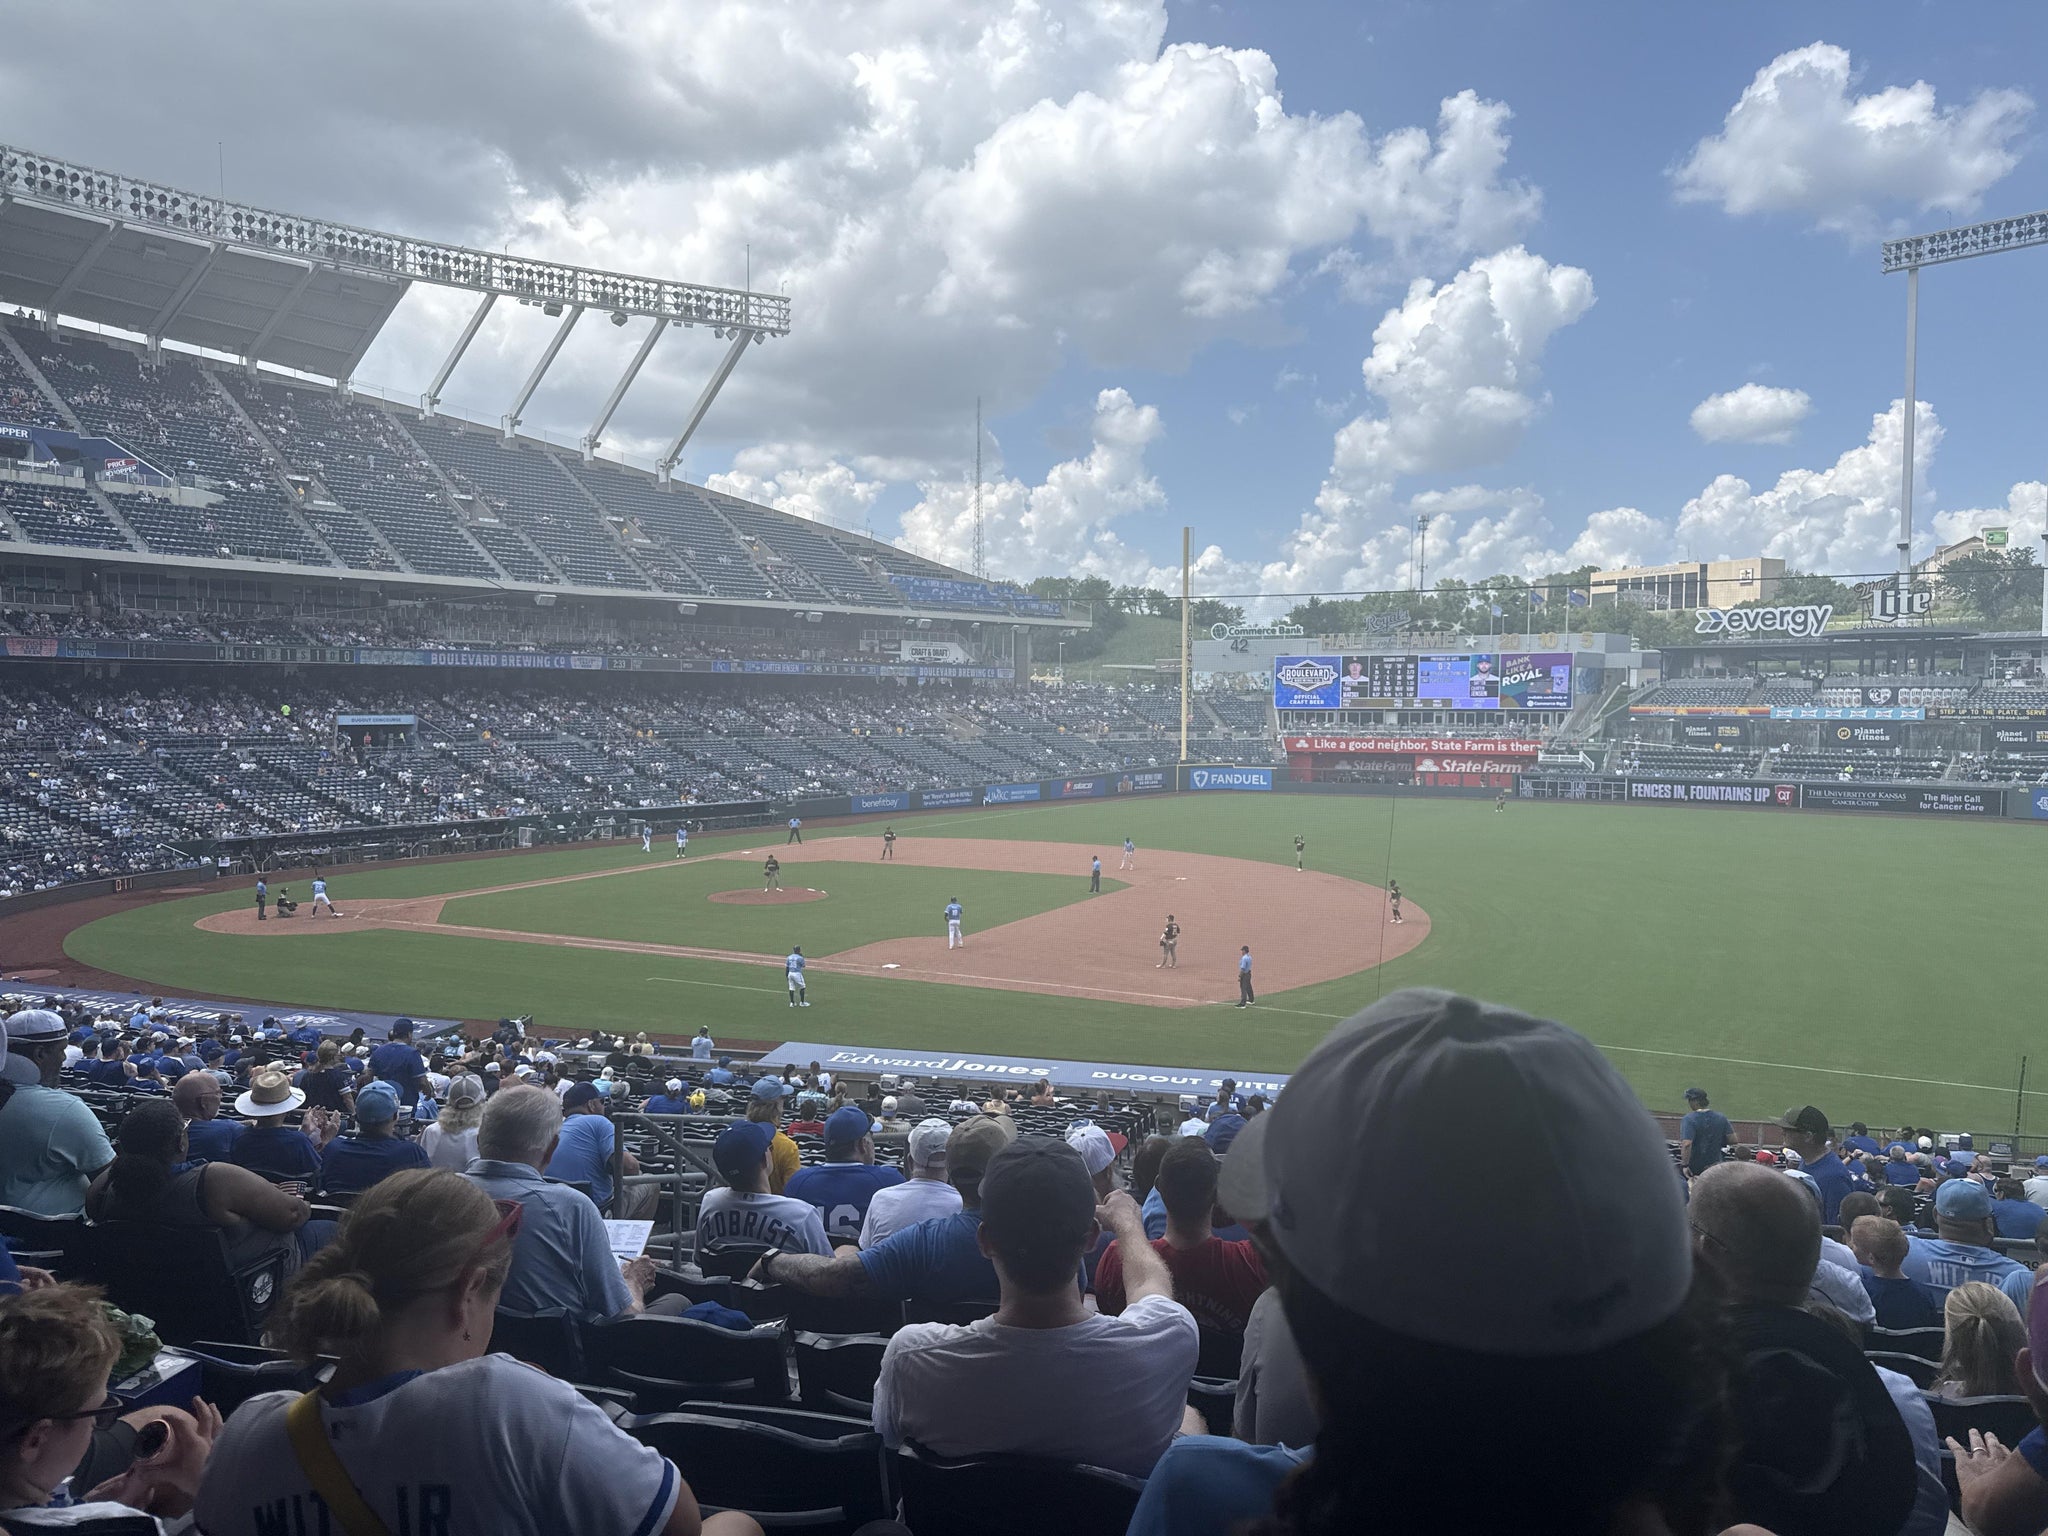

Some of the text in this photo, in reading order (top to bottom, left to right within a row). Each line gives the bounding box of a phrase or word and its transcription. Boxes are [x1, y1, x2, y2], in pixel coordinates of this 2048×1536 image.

[107, 460, 126, 469] PRICE
[1854, 580, 1894, 600] Miller
[1869, 589, 1932, 622] Lite
[1365, 608, 1411, 633] Royals
[1726, 606, 1831, 635] evergy
[1228, 625, 1303, 636] Commerce Bank
[1230, 639, 1248, 653] 42
[1321, 633, 1374, 649] HALL
[1397, 631, 1457, 649] FAME
[1501, 633, 1520, 649] 20
[1539, 632, 1557, 648] 10
[1581, 632, 1594, 648] 5
[911, 647, 927, 656] CRAFT
[932, 648, 948, 657] DRAFT
[431, 653, 498, 667] BOULEVARD
[501, 654, 551, 668] BREWING
[1505, 655, 1531, 668] BANK
[762, 663, 781, 672] CARTER
[782, 664, 800, 673] JENSEN
[919, 667, 957, 677] BOULEVARD
[958, 668, 986, 678] BREWING
[1285, 668, 1330, 681] BOULEVARD
[1505, 664, 1526, 675] LIKE
[1502, 668, 1543, 687] ROYAL
[1854, 727, 1884, 736] planet
[1858, 733, 1890, 741] fitness
[1996, 730, 2022, 738] planet
[1314, 740, 1337, 749] Like
[1349, 740, 1374, 751] good
[1377, 740, 1428, 752] neighbor,
[1431, 741, 1462, 751] State
[1465, 741, 1494, 751] Farm
[1498, 741, 1507, 751] is
[1352, 760, 1412, 771] State Farm
[1441, 759, 1522, 773] State Farm
[1210, 774, 1268, 785] FANDUEL
[1631, 783, 1770, 802] FENCES IN, FOUNTAINS UP
[1777, 790, 1791, 801] QT
[1807, 789, 1822, 797] THE
[1823, 789, 1867, 798] UNIVERSITY
[1879, 792, 1907, 800] KANSAS
[1923, 793, 1981, 804] The Right Call
[862, 797, 899, 808] benefitbay
[1933, 802, 1963, 810] Cancer
[1964, 803, 1985, 812] Care
[1091, 1071, 1203, 1085] DUGOUT
[702, 1210, 796, 1248] ZOBRIST
[1928, 1261, 1973, 1287] WITT
